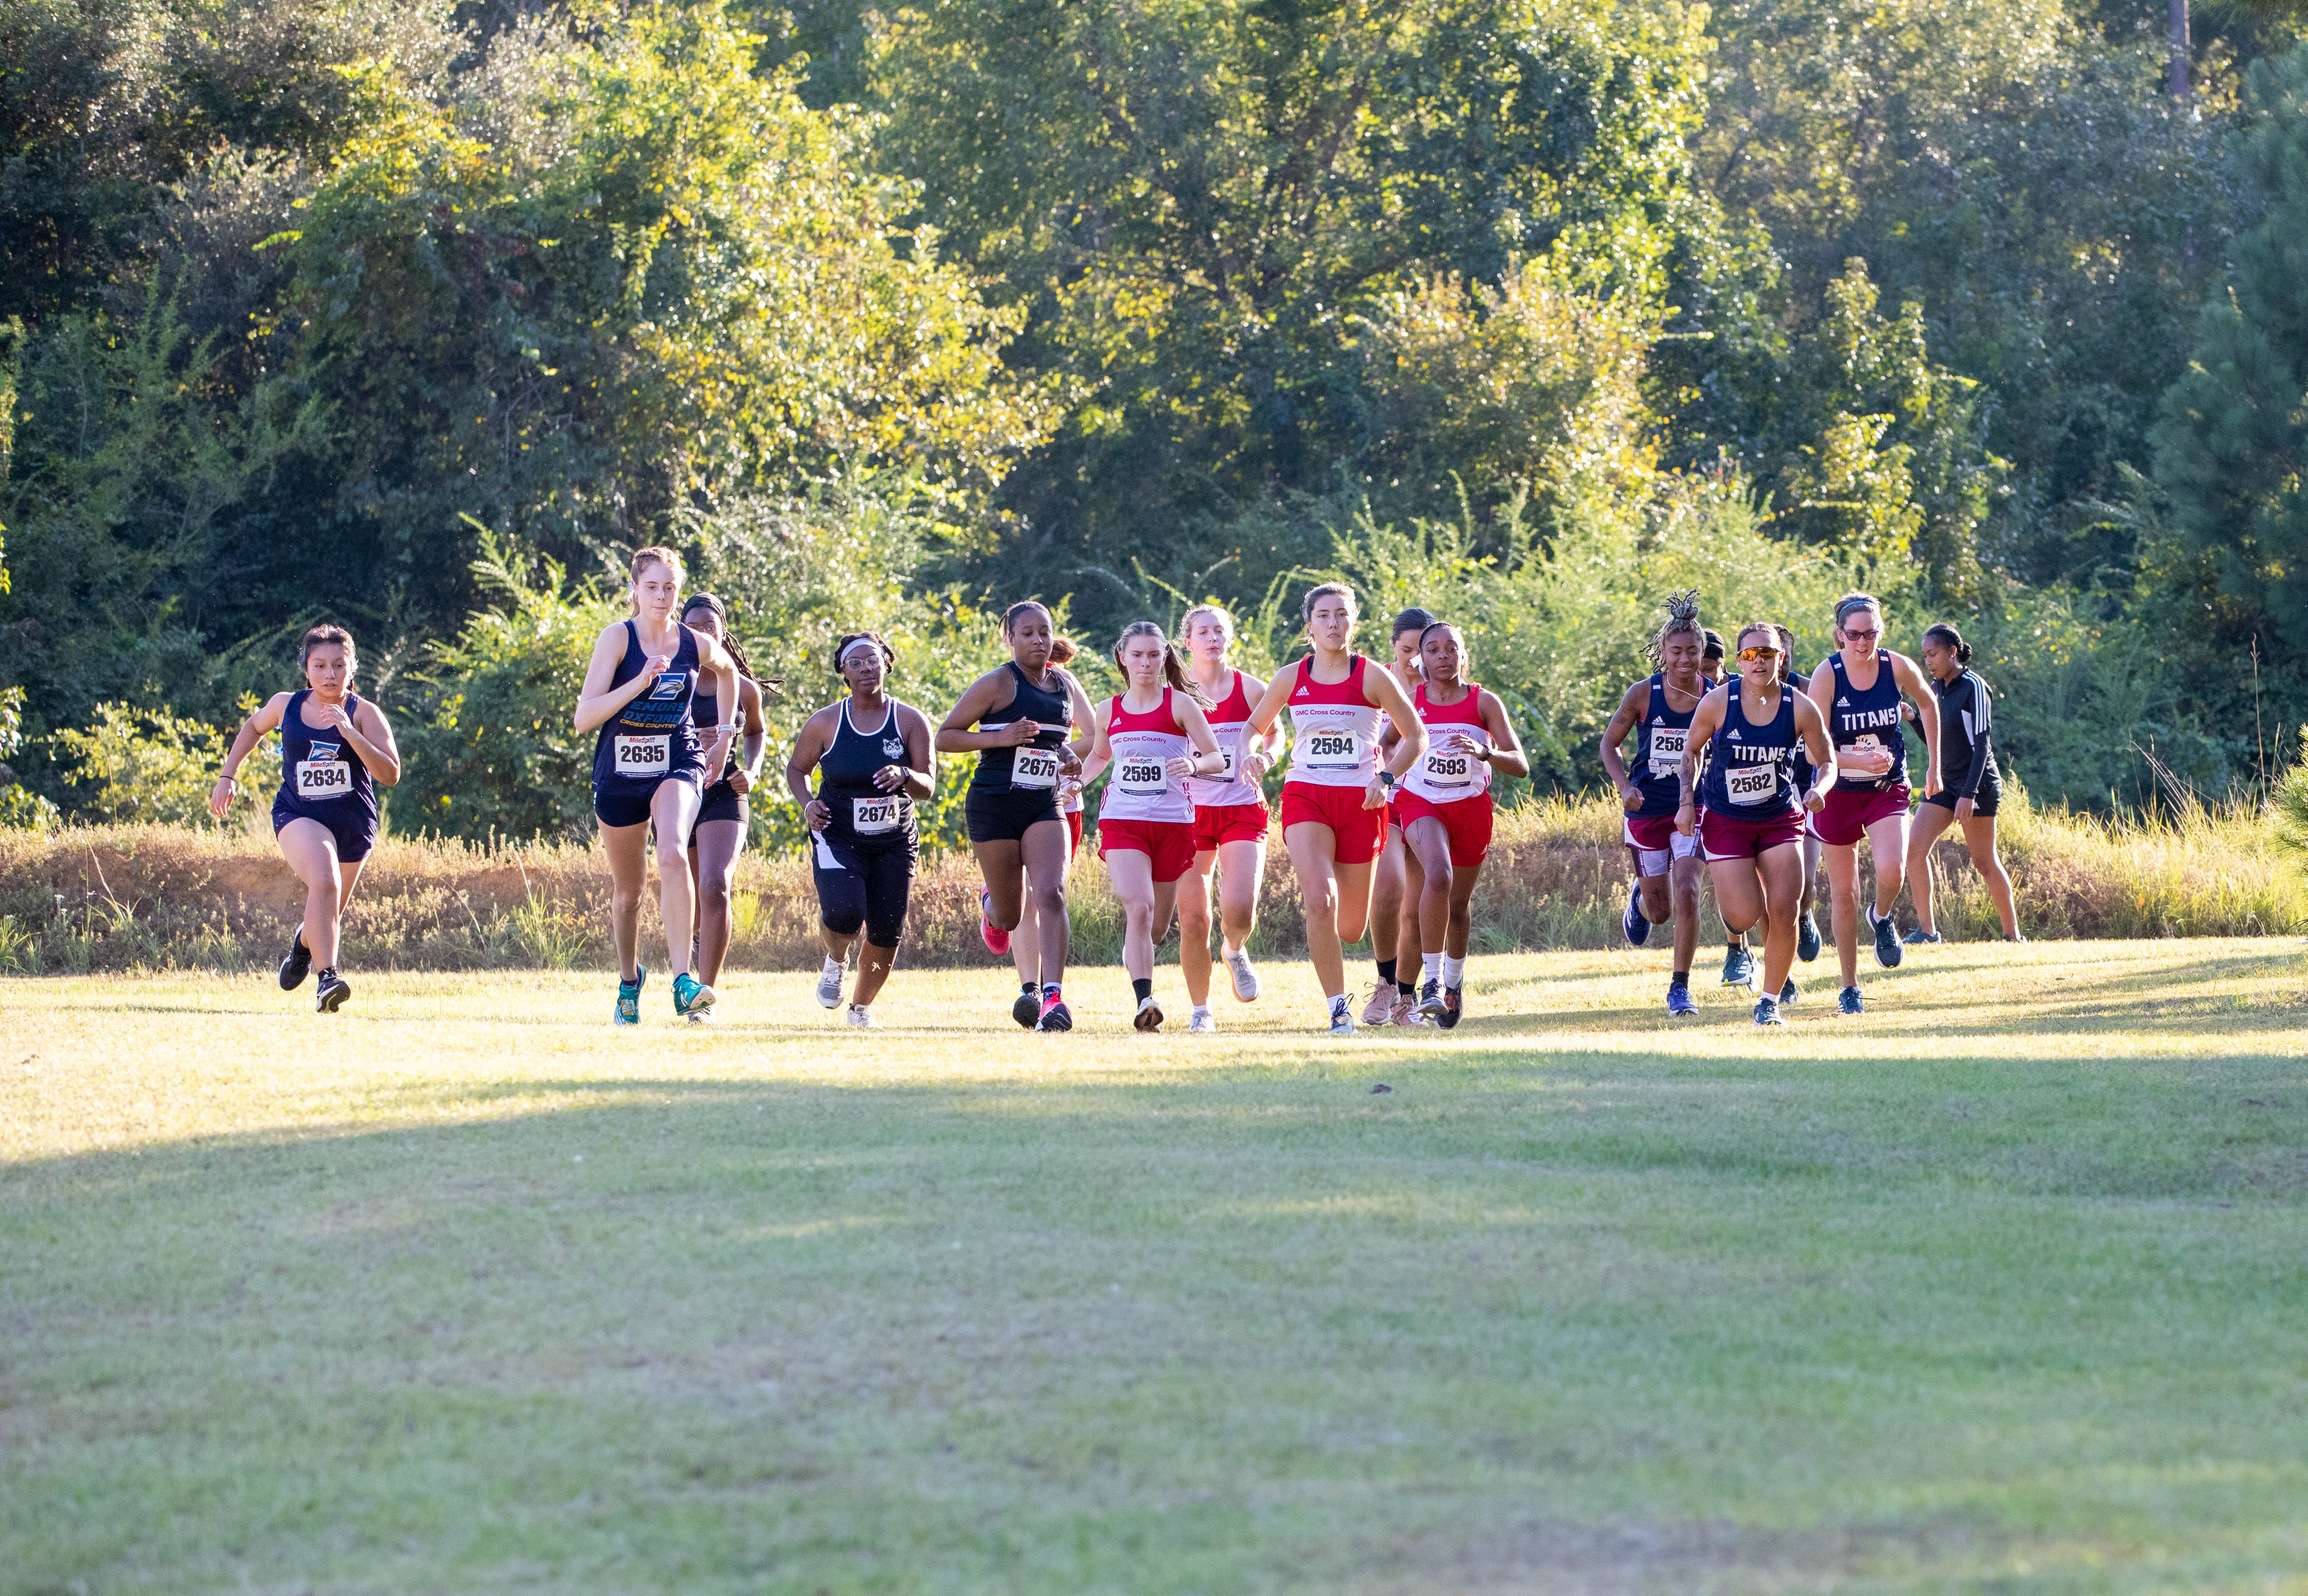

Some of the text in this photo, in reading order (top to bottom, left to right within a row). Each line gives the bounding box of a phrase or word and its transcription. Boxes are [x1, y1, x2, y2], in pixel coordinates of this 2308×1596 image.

[630, 701, 685, 712] EMORY
[1329, 709, 1356, 717] Country
[620, 719, 645, 728] CROSS
[623, 711, 681, 723] OXFORD
[1842, 707, 1897, 731] TITANS
[1141, 736, 1167, 744] Country
[1446, 728, 1471, 736] Country
[1311, 737, 1354, 755] 2594
[1655, 735, 1687, 752] 258
[620, 745, 665, 763] 2635
[1436, 750, 1459, 758] MileSplit
[1732, 745, 1787, 762] TITANS
[1018, 757, 1056, 777] 2675
[1122, 765, 1162, 782] 2599
[1427, 756, 1467, 775] 2593
[1738, 767, 1763, 775] MileSplit
[302, 768, 346, 787] 2634
[1731, 773, 1773, 794] 2582
[858, 804, 896, 822] 2674
